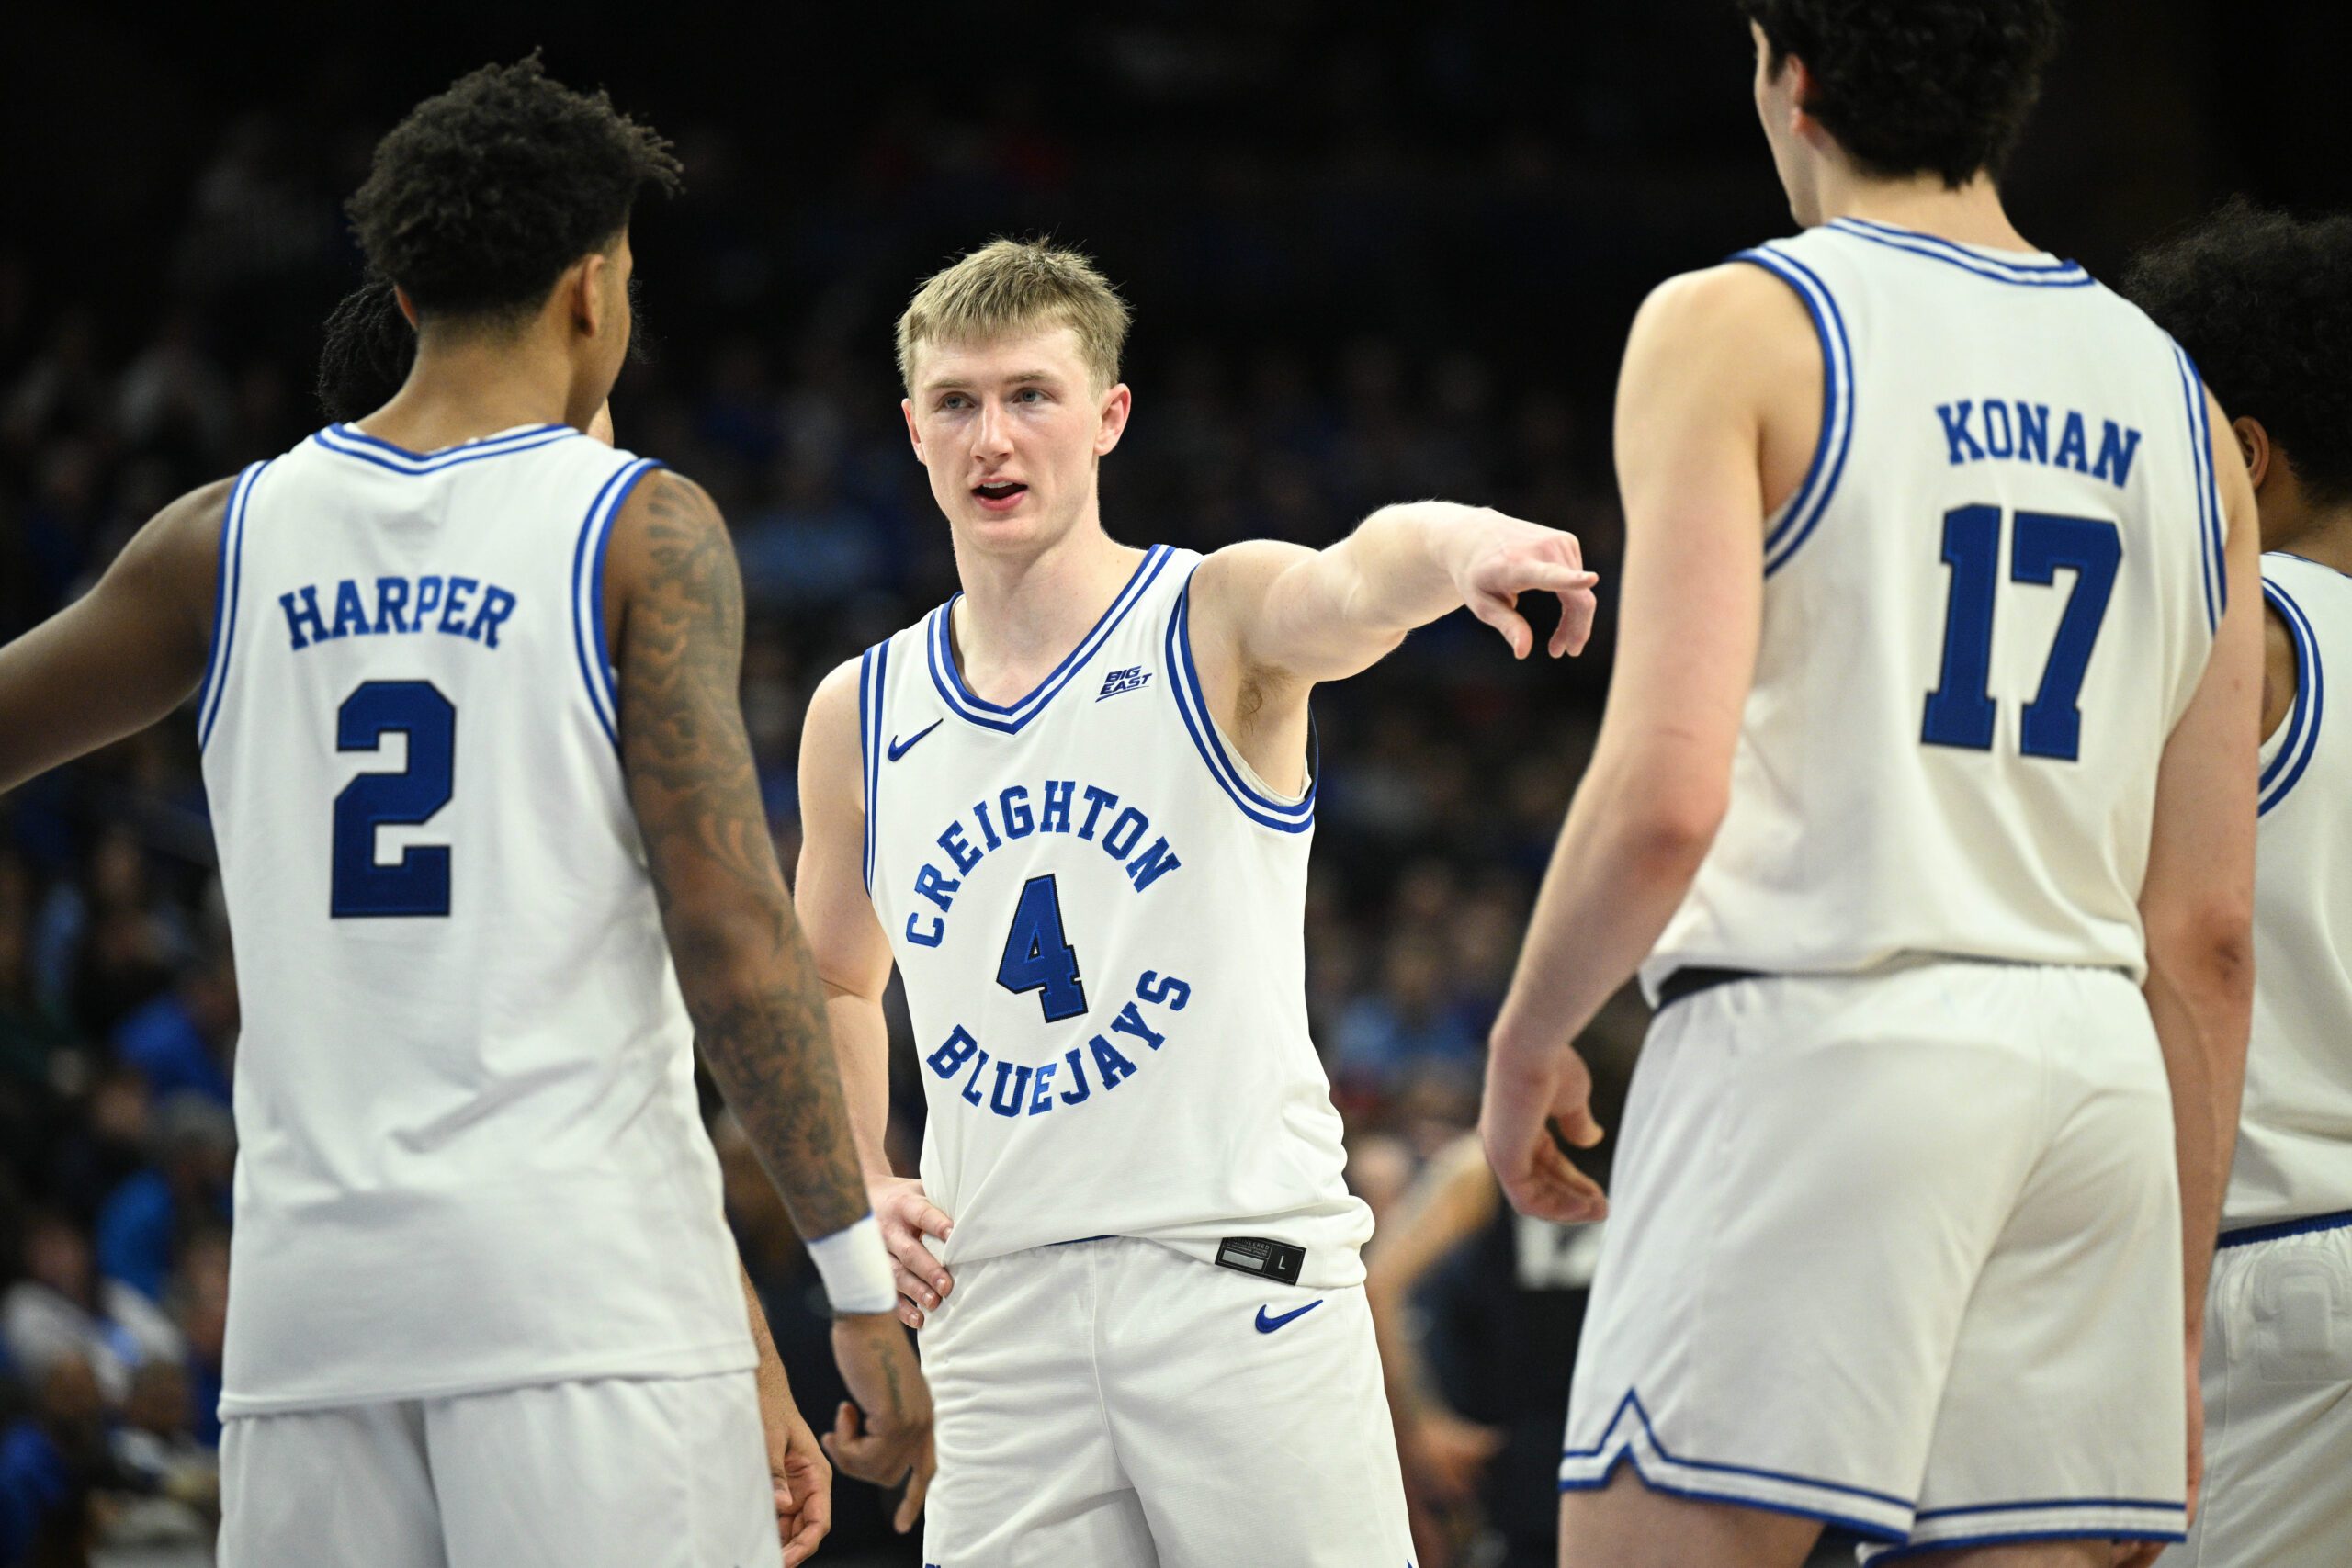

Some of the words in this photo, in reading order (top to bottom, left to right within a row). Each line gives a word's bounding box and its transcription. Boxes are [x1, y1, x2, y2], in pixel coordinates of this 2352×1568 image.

[1936, 399, 2142, 488] KONAN
[278, 575, 516, 650] HARPER
[1921, 503, 2122, 762] 17
[1100, 672, 1153, 695] EAST
[1104, 665, 1142, 683] BIG
[332, 680, 455, 919] 2
[905, 780, 1182, 948] CREIGHTON
[995, 873, 1090, 1024] 4
[926, 969, 1192, 1118] BLUEJAYS
[1278, 1255, 1286, 1270] L
